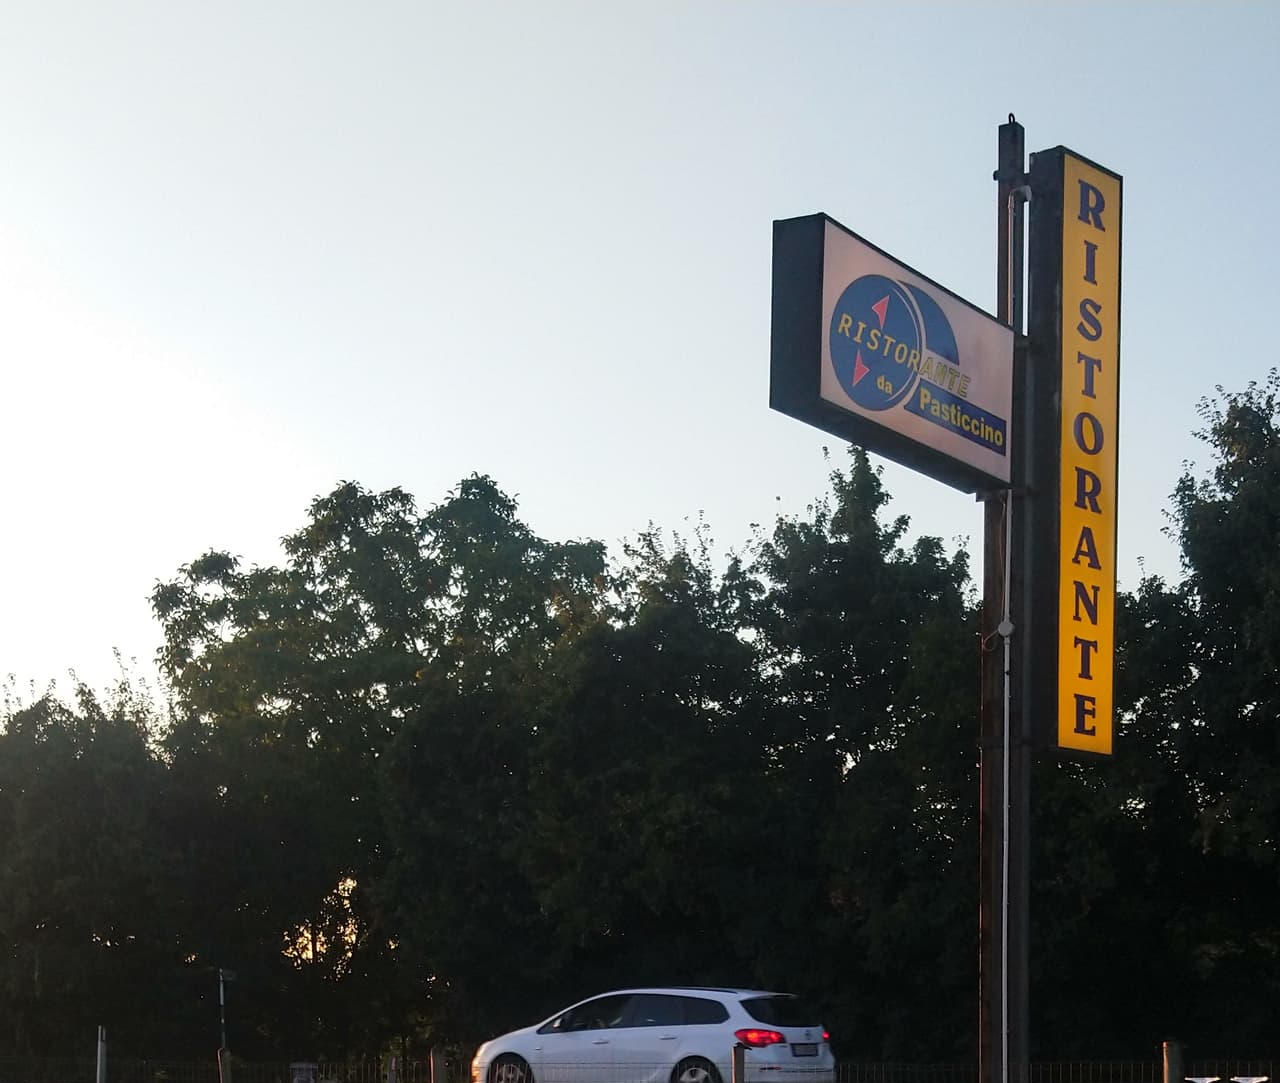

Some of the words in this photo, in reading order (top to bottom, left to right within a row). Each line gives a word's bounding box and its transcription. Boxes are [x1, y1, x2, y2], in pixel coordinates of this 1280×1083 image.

[838, 312, 972, 398] RISTORANTE
[877, 375, 893, 395] da
[919, 386, 1004, 447] Pasticcino
[1072, 178, 1106, 737] RISTORANTE
